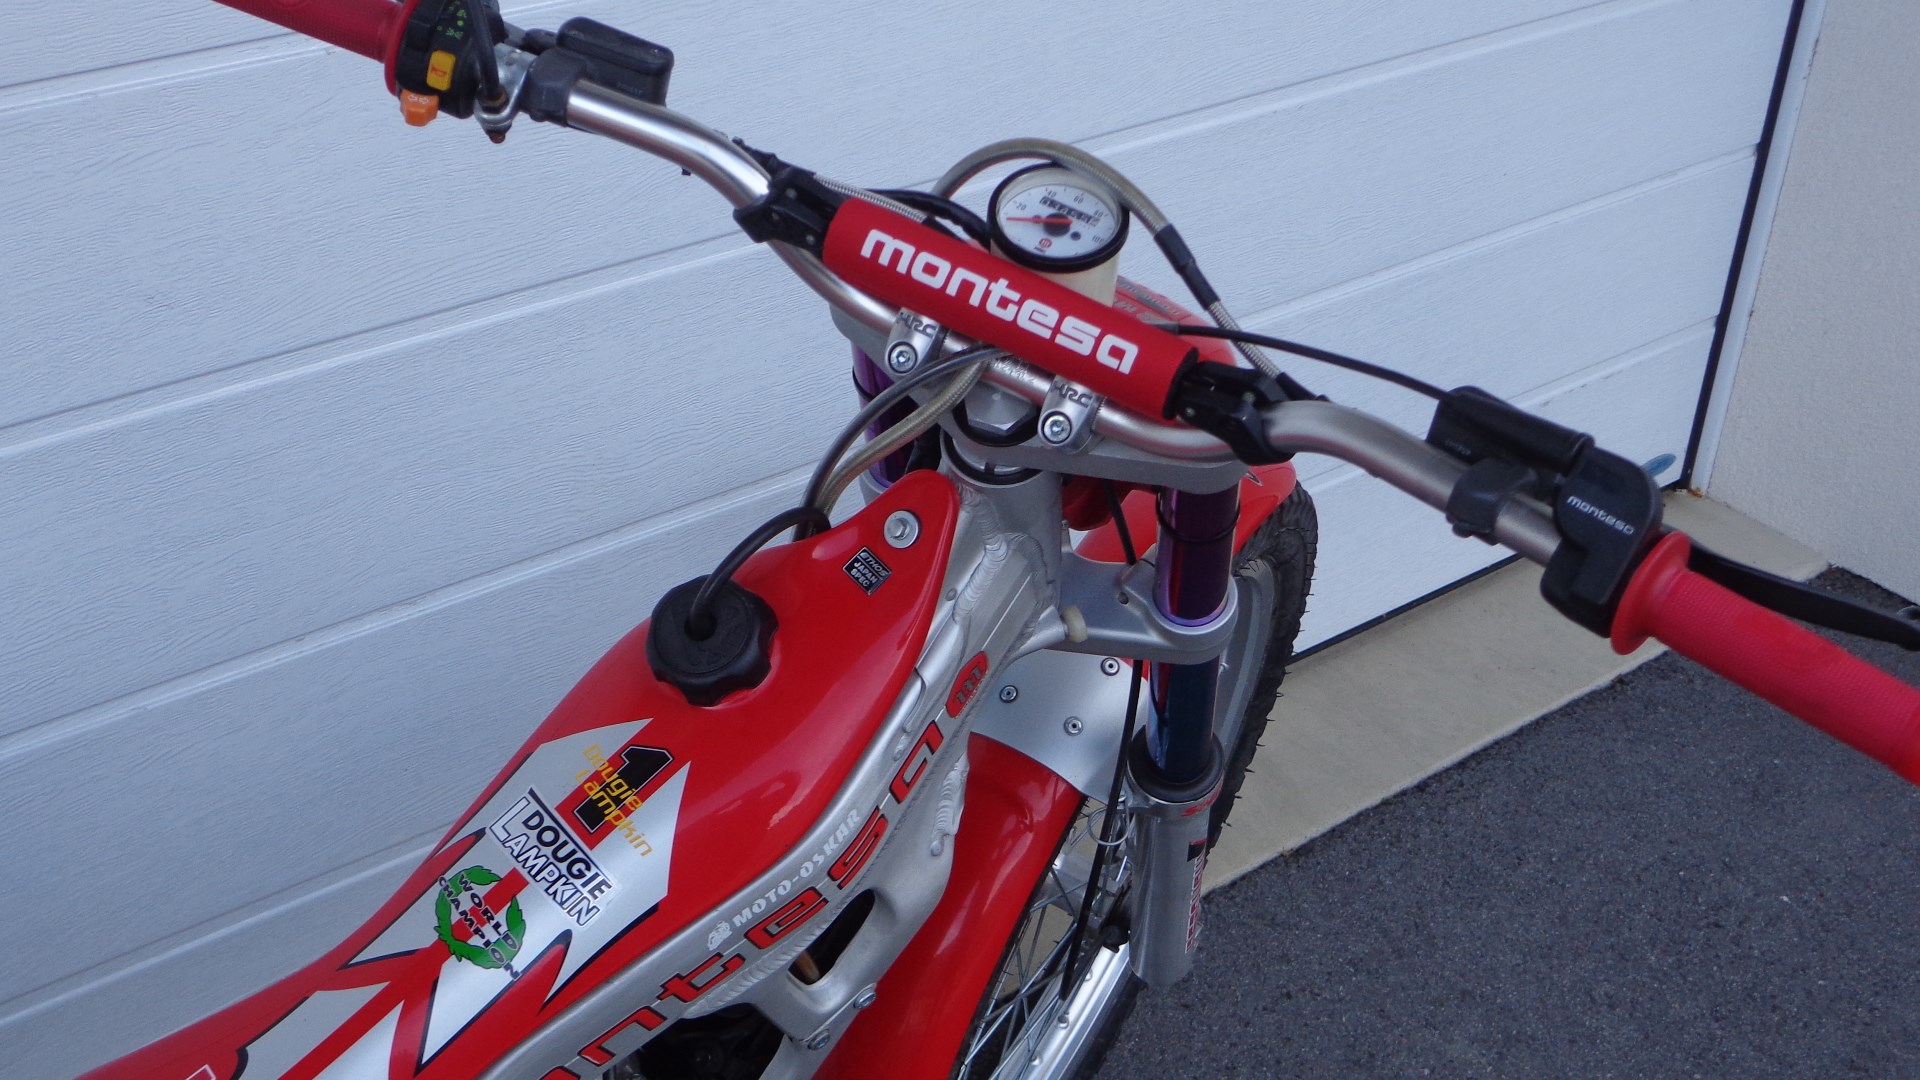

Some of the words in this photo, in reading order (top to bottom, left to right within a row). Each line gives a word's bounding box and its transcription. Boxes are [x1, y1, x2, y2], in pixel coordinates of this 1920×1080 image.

[1016, 203, 1027, 211] 20
[860, 229, 1139, 374] montesa
[896, 311, 937, 339] HRC
[1050, 381, 1093, 408] HRC
[1566, 495, 1635, 536] montesa
[850, 568, 870, 587] SPEC
[854, 562, 878, 584] JAPAN
[573, 744, 674, 834] 1
[575, 768, 653, 857] Lampkin
[582, 743, 643, 811] Dougie
[489, 796, 600, 928] LAMPKIN
[522, 809, 614, 902] DOUGIE
[732, 809, 861, 927] MOTO-OSKAR
[438, 876, 521, 980] CHAMPION
[458, 874, 518, 951] WORLD
